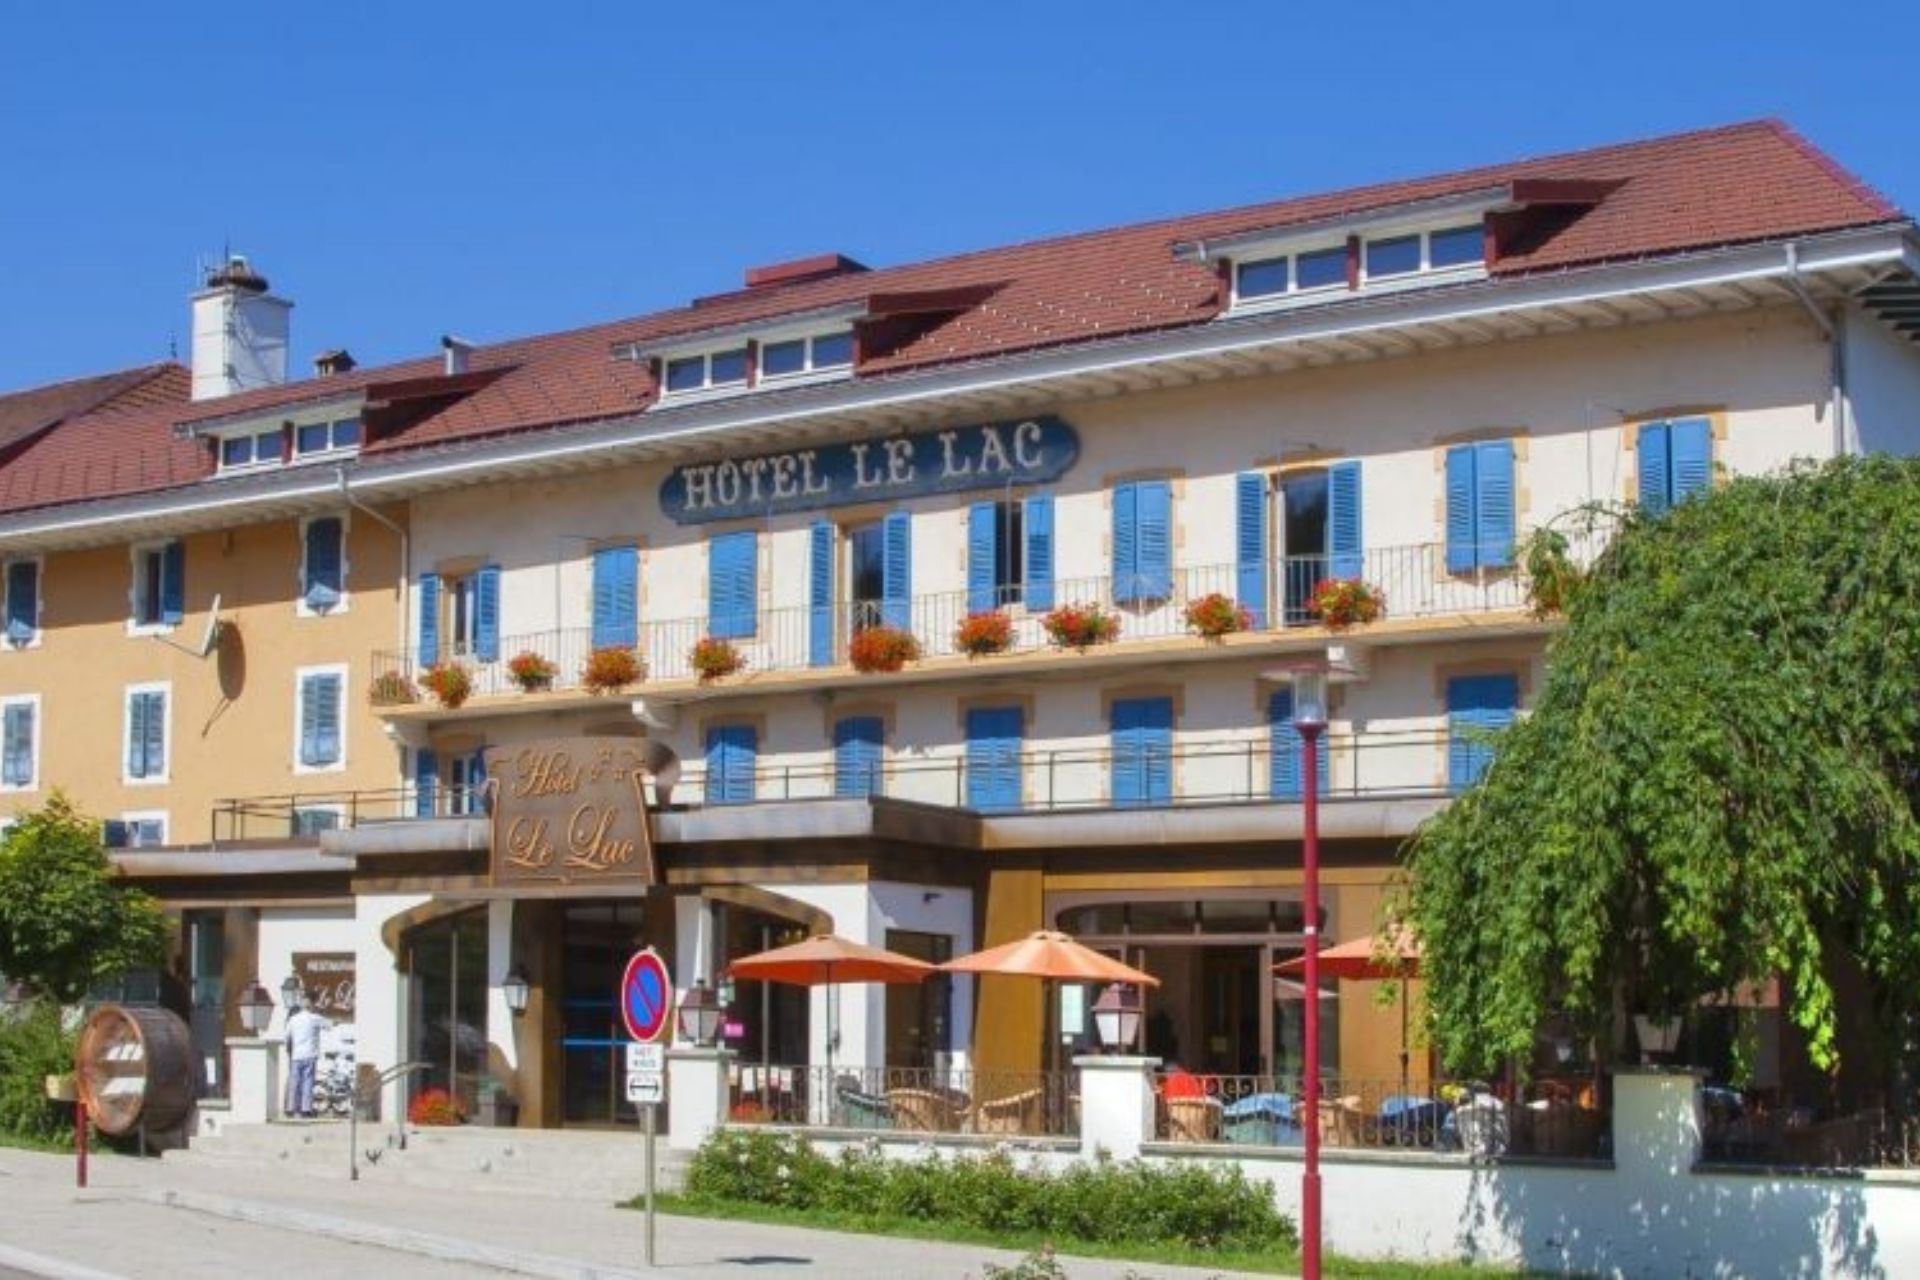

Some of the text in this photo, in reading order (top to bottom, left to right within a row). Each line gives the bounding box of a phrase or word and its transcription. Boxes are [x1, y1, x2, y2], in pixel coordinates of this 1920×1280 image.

[852, 439, 914, 488] LE
[939, 421, 1043, 477] LAC
[504, 815, 553, 868] Le
